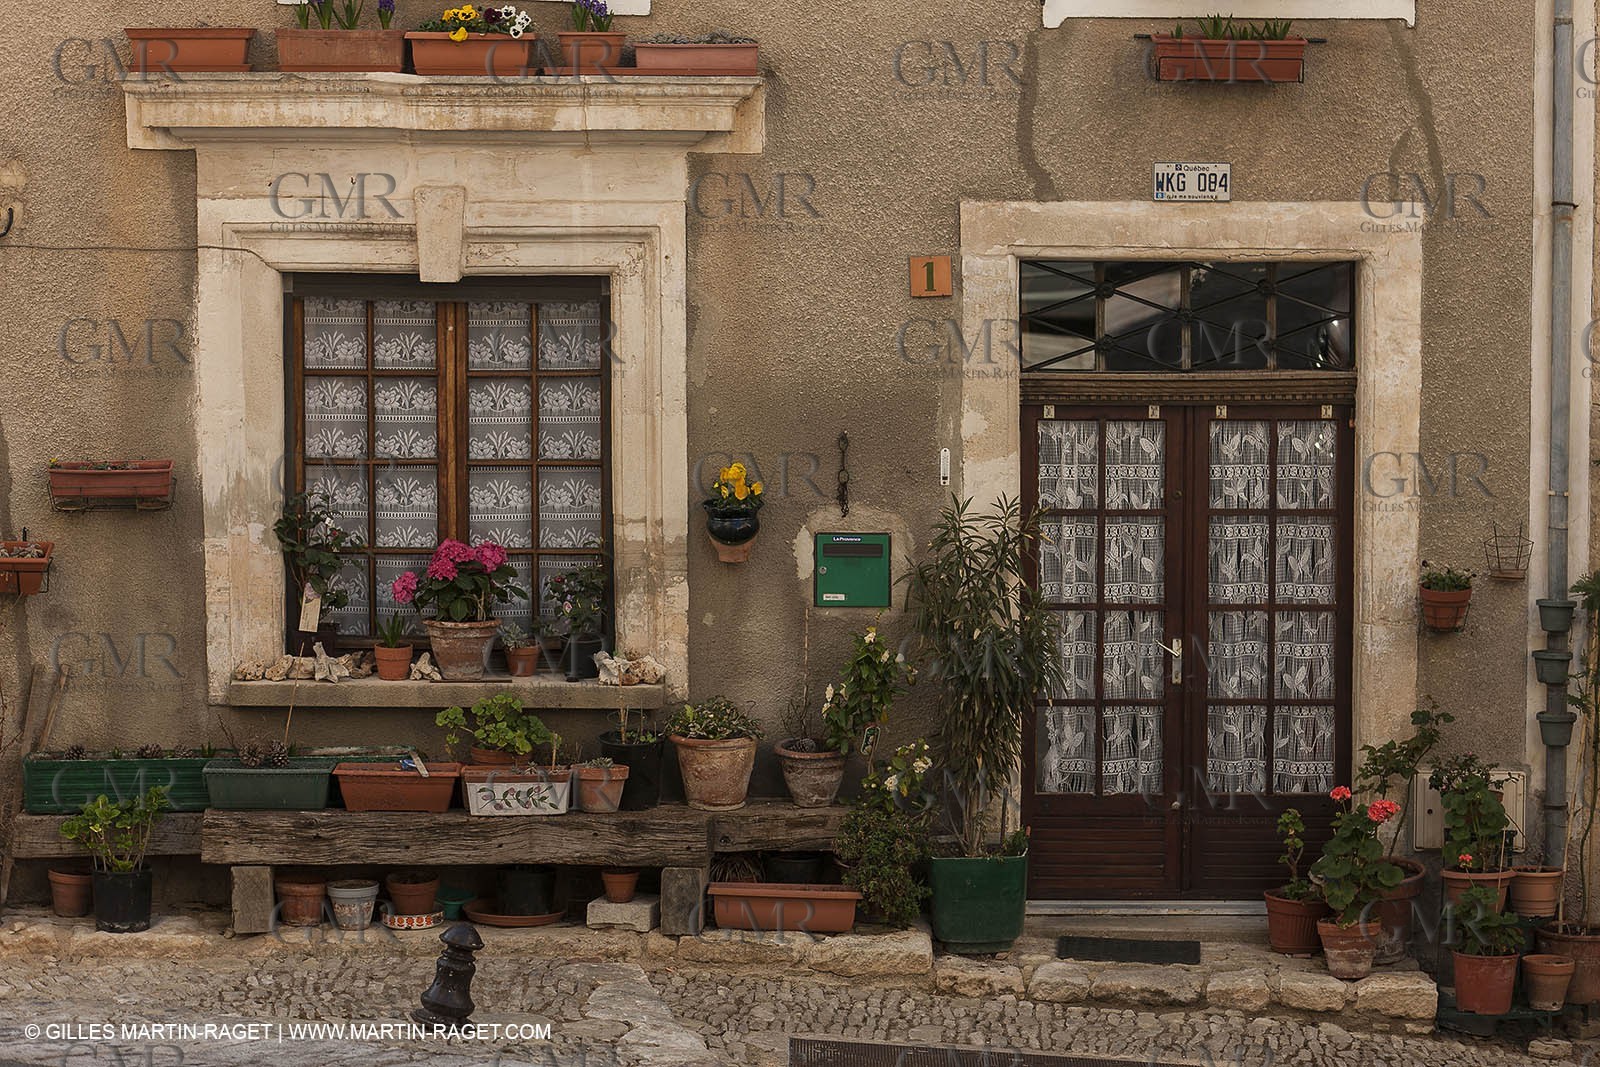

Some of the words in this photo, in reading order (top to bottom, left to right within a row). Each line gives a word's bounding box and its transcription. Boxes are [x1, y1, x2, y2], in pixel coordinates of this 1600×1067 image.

[1184, 164, 1210, 172] Québec
[1156, 172, 1186, 192] WKG
[1198, 172, 1228, 192] 084
[922, 262, 936, 291] 1
